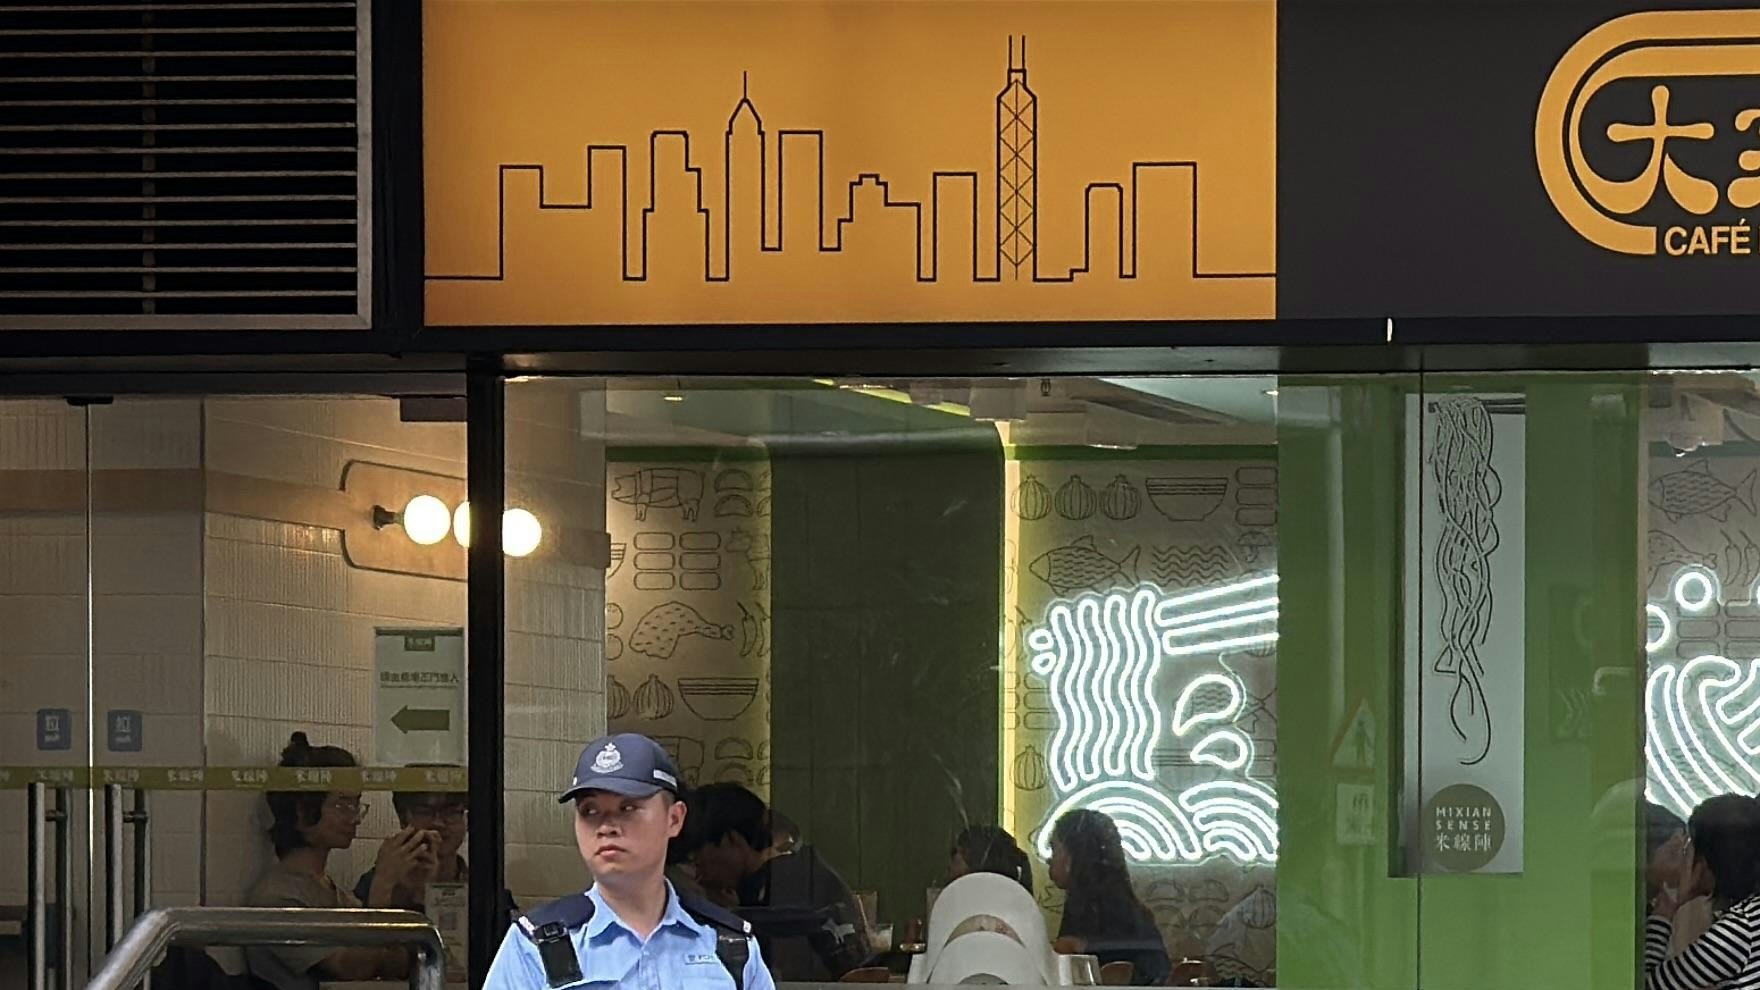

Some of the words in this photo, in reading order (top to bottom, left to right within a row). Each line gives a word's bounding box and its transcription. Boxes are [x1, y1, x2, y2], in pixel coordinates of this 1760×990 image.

[1664, 219, 1751, 256] CAFÉ
[1435, 806, 1492, 817] MIXIAN
[1435, 820, 1492, 831] SENSE
